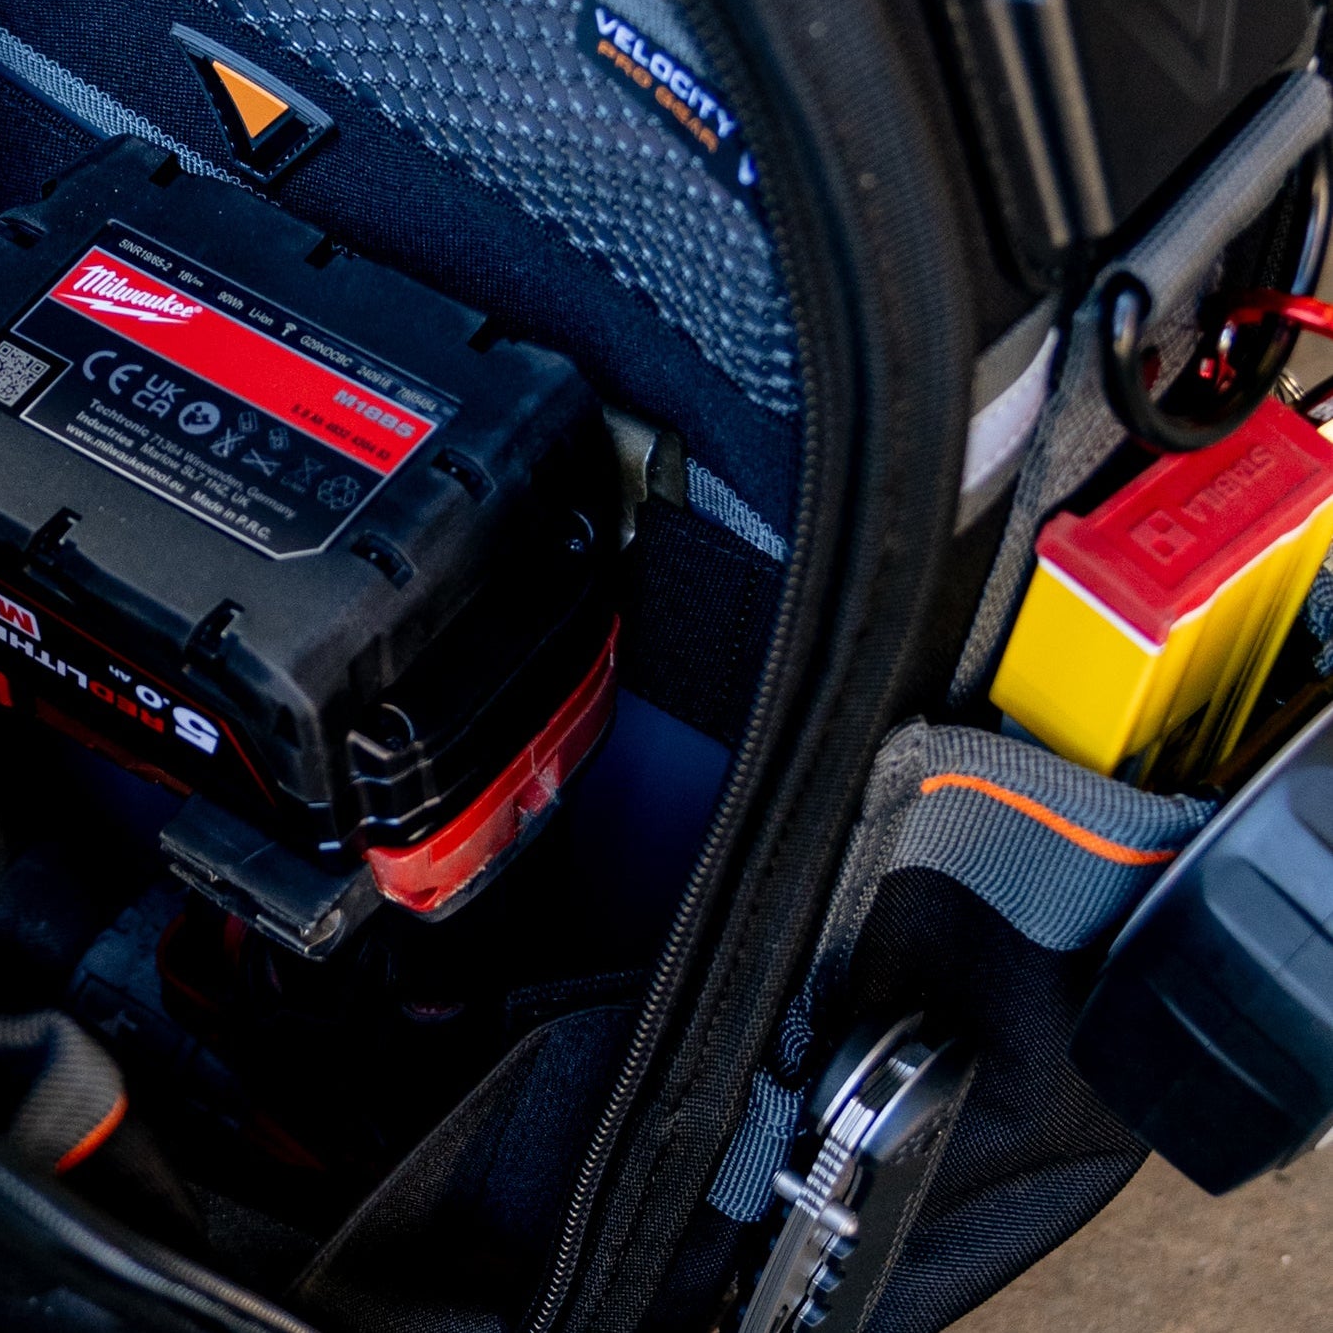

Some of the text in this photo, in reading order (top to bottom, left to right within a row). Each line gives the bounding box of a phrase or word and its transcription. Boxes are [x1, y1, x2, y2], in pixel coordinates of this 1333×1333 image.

[595, 7, 736, 139] VELOCITY
[73, 264, 196, 318] Milwaukee
[118, 238, 174, 272] 5INR19/65-2
[217, 291, 245, 310] 90Wh
[248, 307, 274, 326] Li-ion
[82, 350, 144, 395] CE
[75, 410, 135, 448] Industries
[89, 397, 151, 438] Techtronic
[65, 422, 272, 542] www.milwaukeetool.eu Made in P.R.C.
[139, 442, 182, 471] Marlow
[230, 491, 252, 509] UK
[246, 485, 298, 521] Germany
[1180, 444, 1277, 524] STABILA
[134, 683, 221, 756] 5.0
